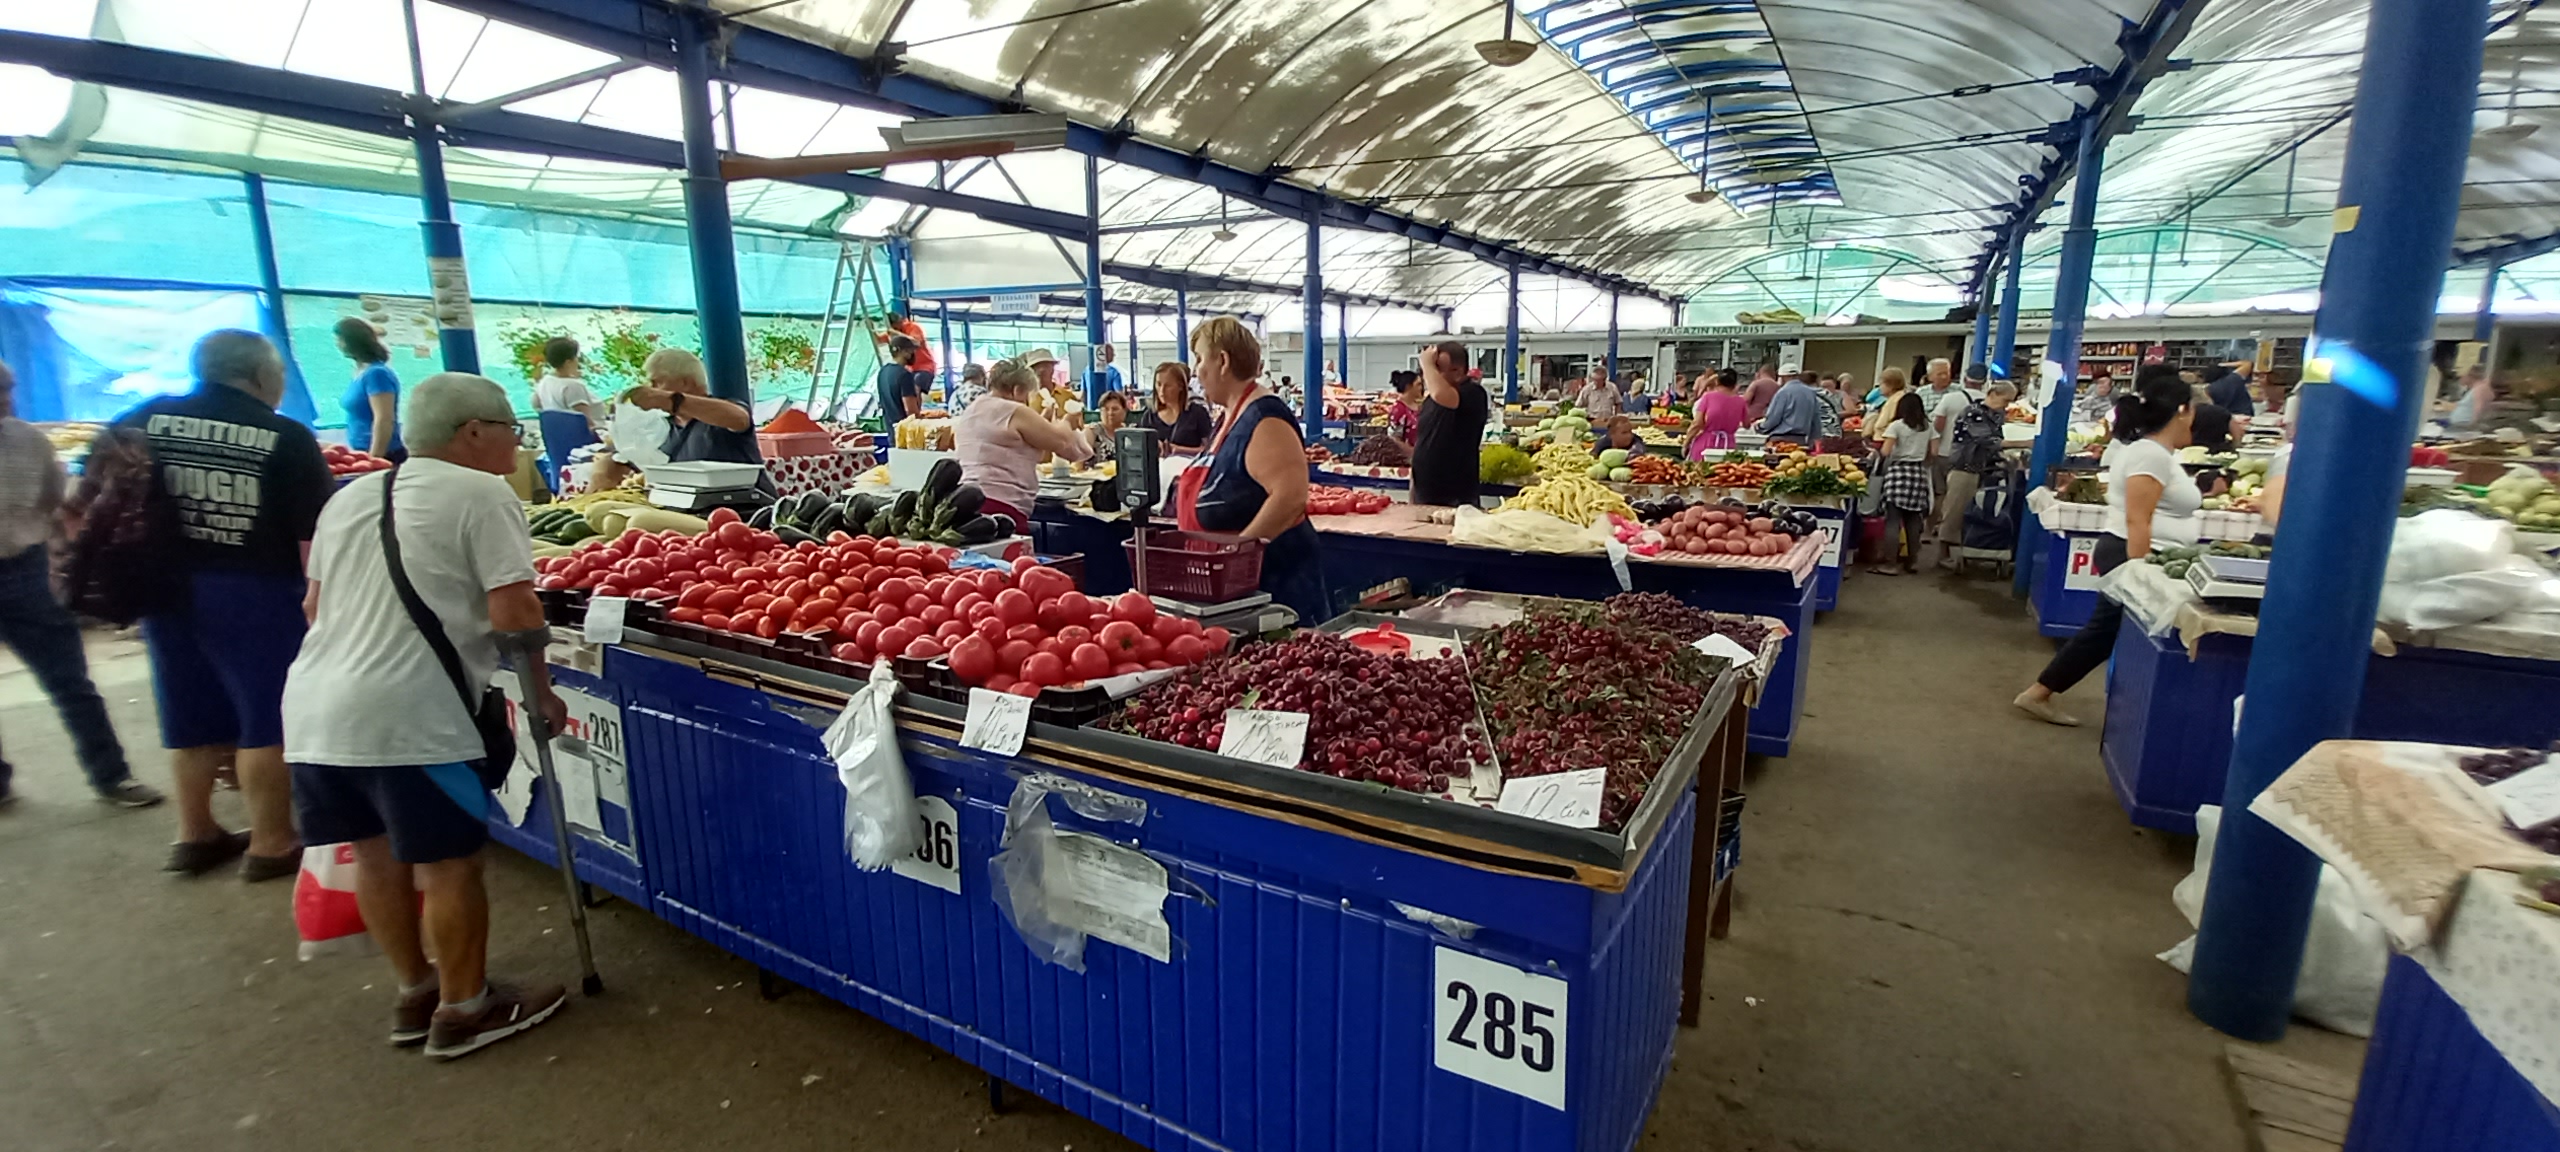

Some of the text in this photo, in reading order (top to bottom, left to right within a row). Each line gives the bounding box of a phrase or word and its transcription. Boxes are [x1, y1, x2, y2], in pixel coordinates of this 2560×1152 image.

[1656, 326, 1709, 335] MAGAZIN
[1712, 325, 1766, 335] NATURIST
[2072, 553, 2099, 575] P
[589, 712, 619, 756] 287
[909, 814, 954, 869] 86
[1447, 980, 1555, 1073] 285
